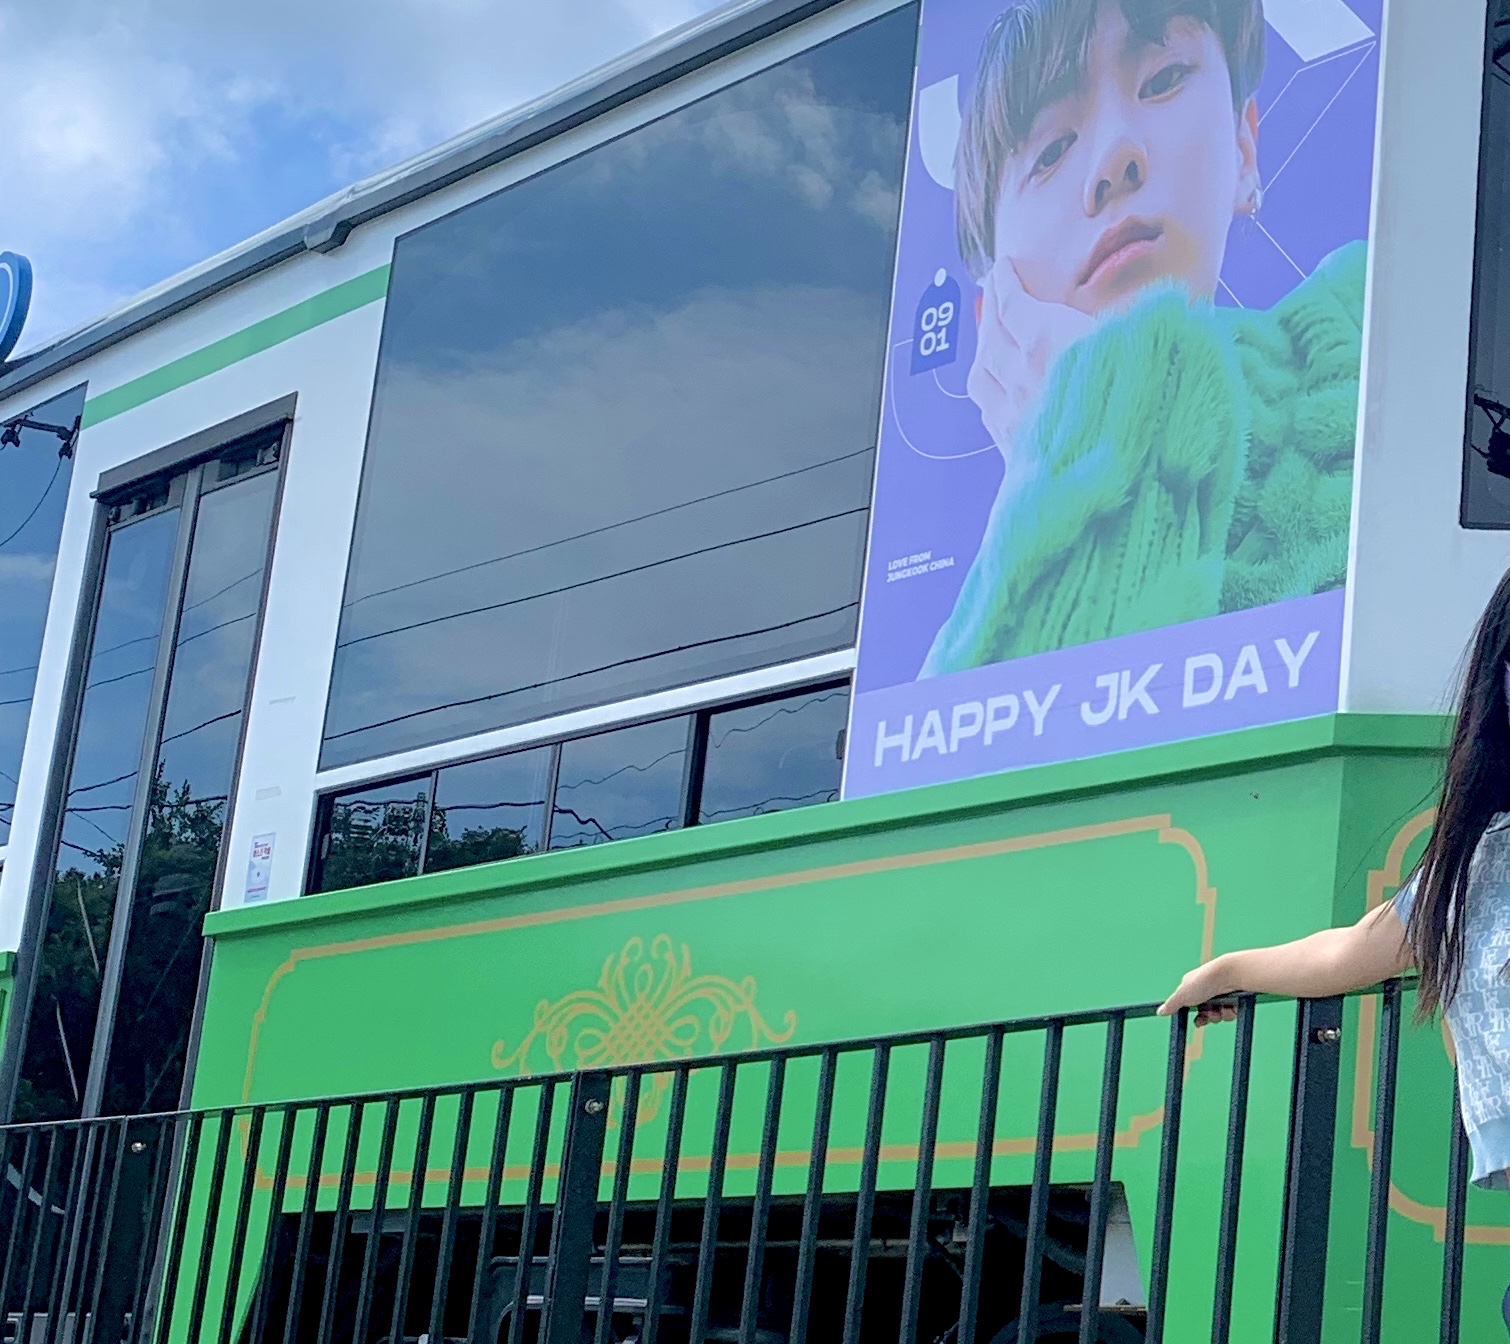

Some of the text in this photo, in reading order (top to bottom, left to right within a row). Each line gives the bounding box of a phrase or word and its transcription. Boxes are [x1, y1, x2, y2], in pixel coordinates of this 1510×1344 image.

[921, 301, 954, 331] 09
[920, 327, 950, 356] 01
[888, 551, 931, 570] LOVE FROM
[930, 557, 954, 571] CHINA
[873, 631, 1320, 767] HAPPY JK DAY
